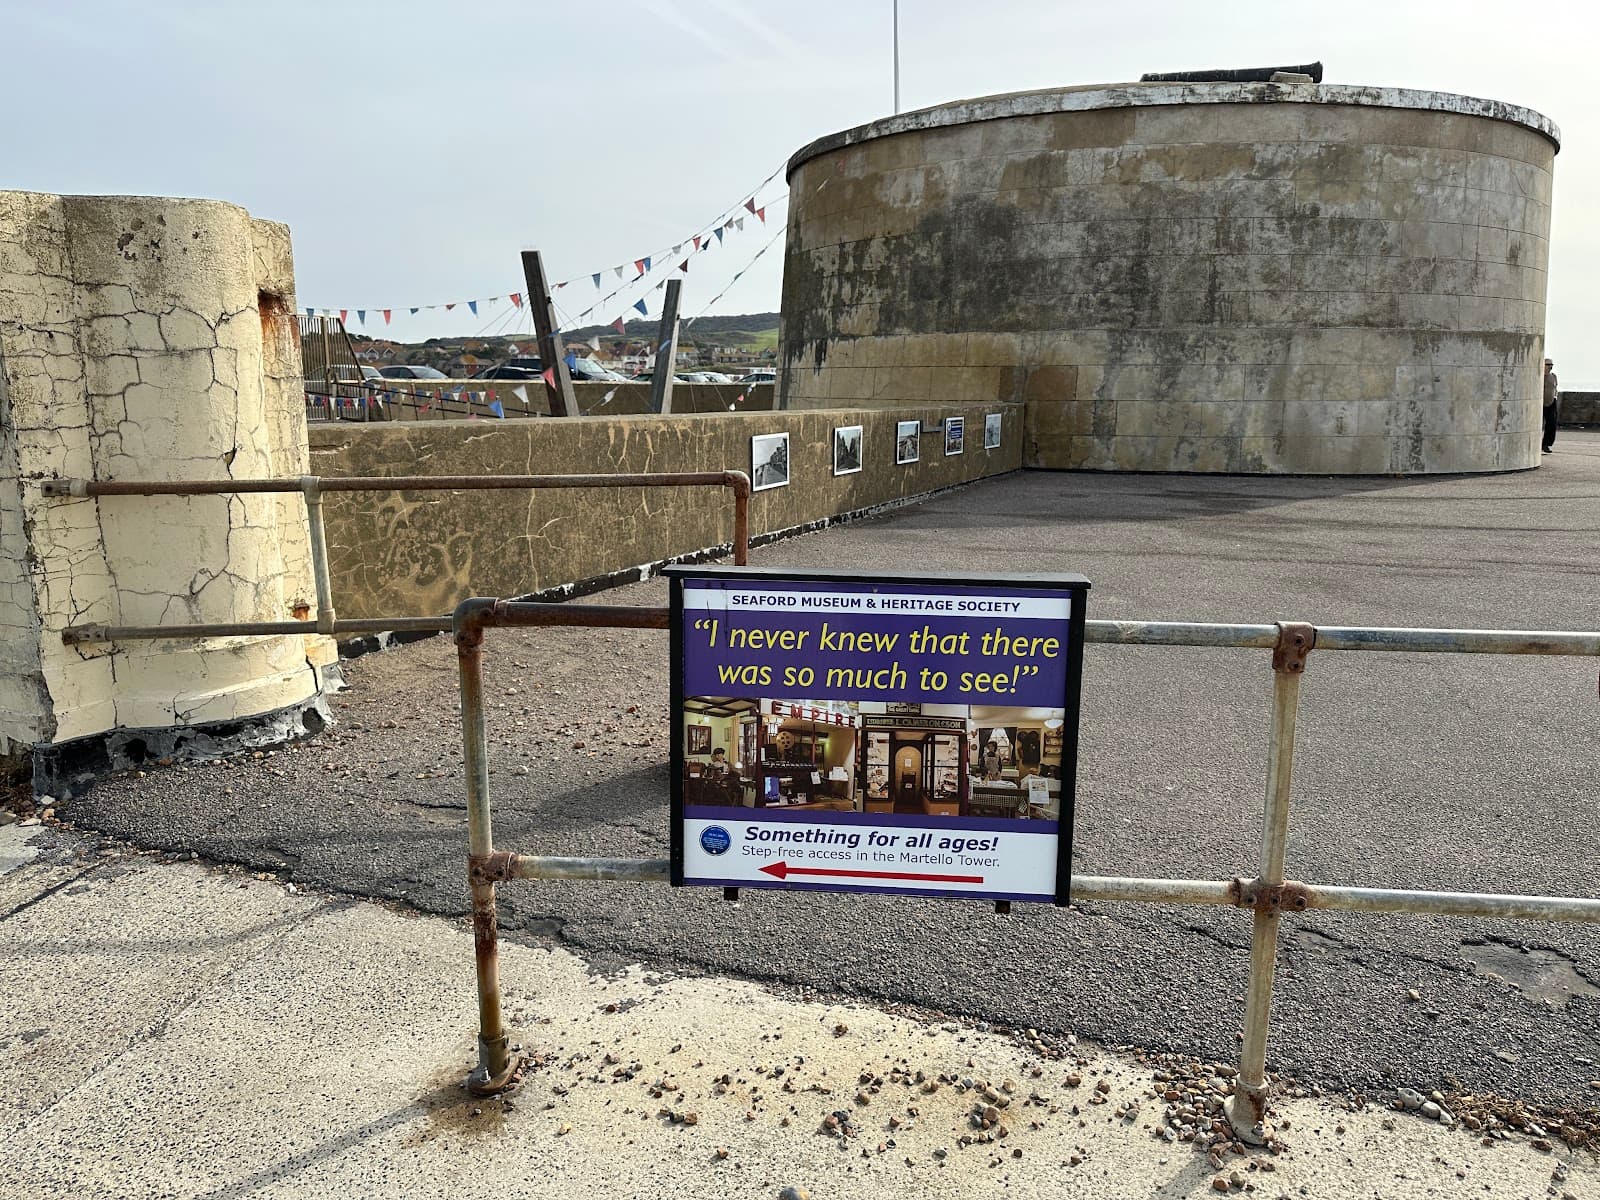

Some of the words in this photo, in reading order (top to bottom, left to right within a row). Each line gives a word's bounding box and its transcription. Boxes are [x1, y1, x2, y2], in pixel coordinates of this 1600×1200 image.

[732, 595, 797, 607] SEAFORD
[801, 597, 861, 608] MUSEUM
[866, 598, 877, 609] &
[881, 599, 953, 611] HERITAGE
[957, 601, 1021, 613] SOCIETY
[729, 628, 810, 650] never
[819, 622, 900, 653] knew
[909, 625, 970, 655] that
[981, 627, 1060, 658] there
[717, 664, 773, 685] was
[783, 666, 815, 687] so
[825, 661, 907, 690] much
[919, 667, 948, 691] to
[771, 700, 856, 728] EMPIRE
[744, 826, 861, 849] Something
[868, 831, 900, 847] for
[905, 833, 933, 849] all
[938, 836, 999, 853] ages!
[742, 845, 804, 859] Step-free
[808, 849, 852, 860] access
[857, 850, 868, 862] in
[873, 851, 895, 862] the
[900, 852, 953, 865] Martello
[957, 854, 1000, 868] Tower.
